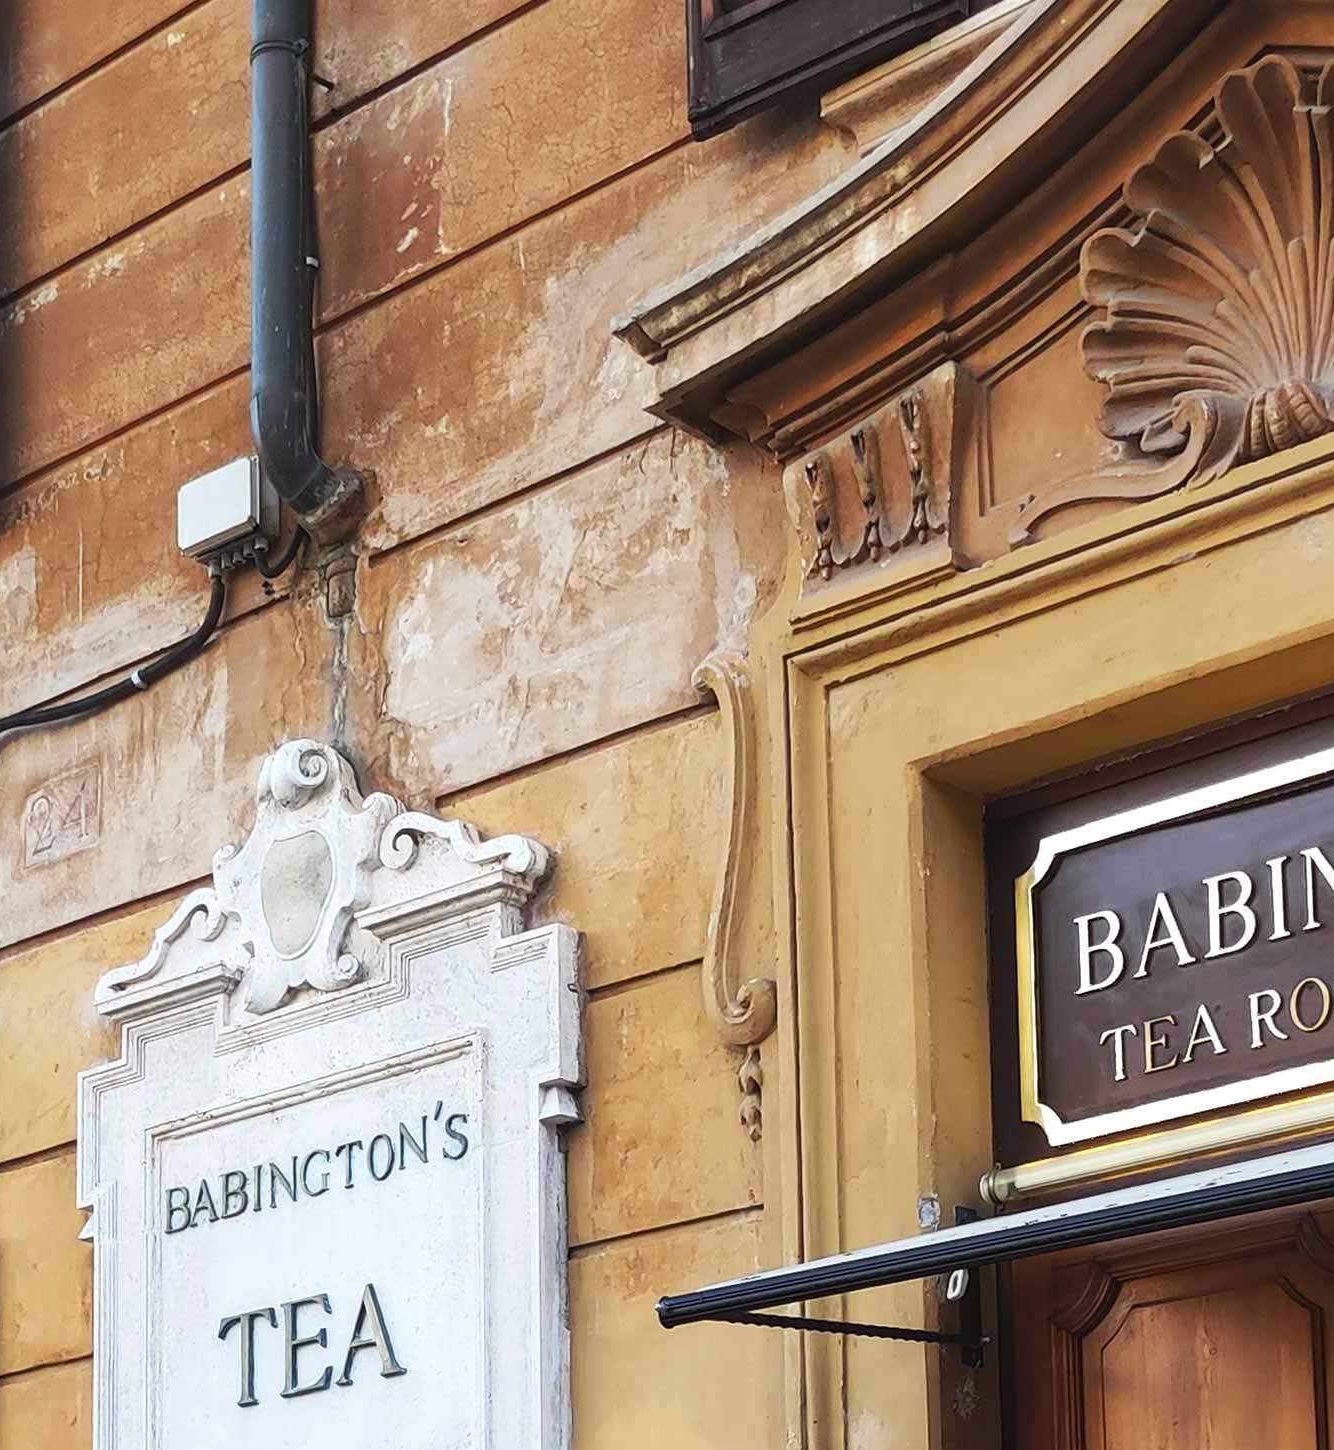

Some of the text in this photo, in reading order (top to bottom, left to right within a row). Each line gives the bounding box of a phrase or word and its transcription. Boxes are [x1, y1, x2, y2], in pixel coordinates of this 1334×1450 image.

[28, 780, 90, 856] 24
[1099, 1004, 1227, 1081] TEA
[165, 1100, 469, 1235] BABINGTON'S
[218, 1283, 407, 1408] TEA
